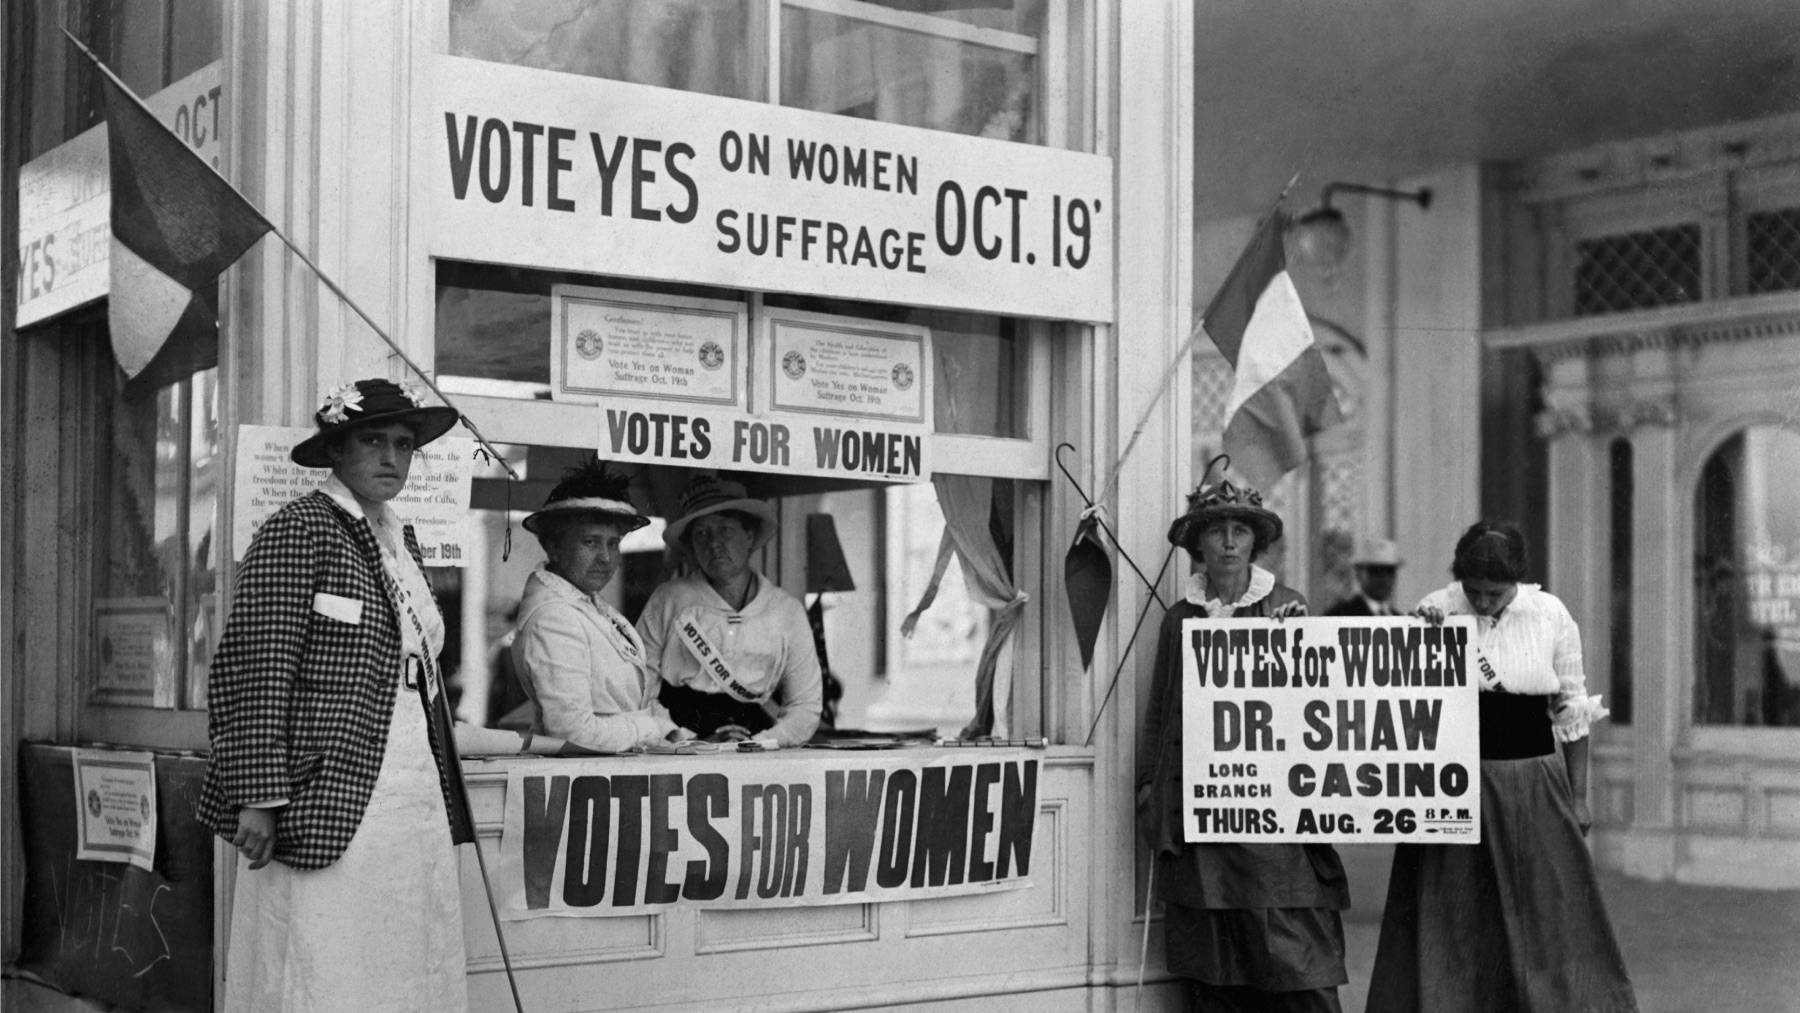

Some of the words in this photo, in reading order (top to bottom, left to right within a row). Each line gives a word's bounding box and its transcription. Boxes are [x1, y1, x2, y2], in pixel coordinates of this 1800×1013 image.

[445, 112, 577, 213] VOTE
[590, 132, 699, 225] YES
[720, 130, 770, 175] ON
[787, 139, 918, 195] WOMEN
[936, 180, 1036, 265] OCT.
[716, 209, 926, 274] SUFFRAGE
[608, 360, 629, 370] Vote
[632, 360, 646, 371] Yes
[649, 364, 660, 373] on
[663, 364, 695, 376] Woman
[614, 371, 648, 384] Suffrage
[811, 378, 829, 389] Vote
[831, 380, 845, 390] Yes
[848, 383, 857, 391] on
[860, 383, 888, 394] Woman
[817, 390, 847, 402] Suffrage
[265, 442, 289, 452] When
[447, 453, 461, 461] the
[607, 409, 711, 460] VOTES
[733, 420, 790, 466] FOR
[814, 427, 921, 477] WOMEN
[252, 475, 287, 485] freedom
[289, 477, 299, 485] of
[301, 478, 315, 486] the
[263, 465, 287, 475] When
[292, 467, 306, 475] the
[426, 473, 441, 482] and
[446, 474, 459, 482] the
[251, 498, 265, 506] the
[262, 488, 287, 498] When
[290, 489, 303, 498] the
[424, 494, 432, 503] of
[435, 495, 458, 504] Cuba,
[421, 542, 437, 559] ber
[440, 542, 462, 559] 19th
[407, 606, 423, 635] FOR
[683, 621, 712, 657] VOTES
[709, 657, 730, 681] FOR
[1192, 628, 1287, 688] VOTES
[1292, 628, 1335, 687] for
[1338, 627, 1468, 687] WOMEN
[1478, 656, 1496, 681] FOR
[1213, 700, 1285, 752] DR.
[1303, 699, 1443, 752] SHAW
[1209, 764, 1257, 778] LONG
[1288, 763, 1469, 798] CASINO
[1194, 784, 1272, 798] BRANCH
[1193, 808, 1284, 834] THURS.
[1374, 808, 1417, 834] 26
[1425, 808, 1436, 819] 8
[523, 773, 729, 910] VOTES
[735, 784, 812, 900] FOR
[823, 760, 1039, 895] WOMEN
